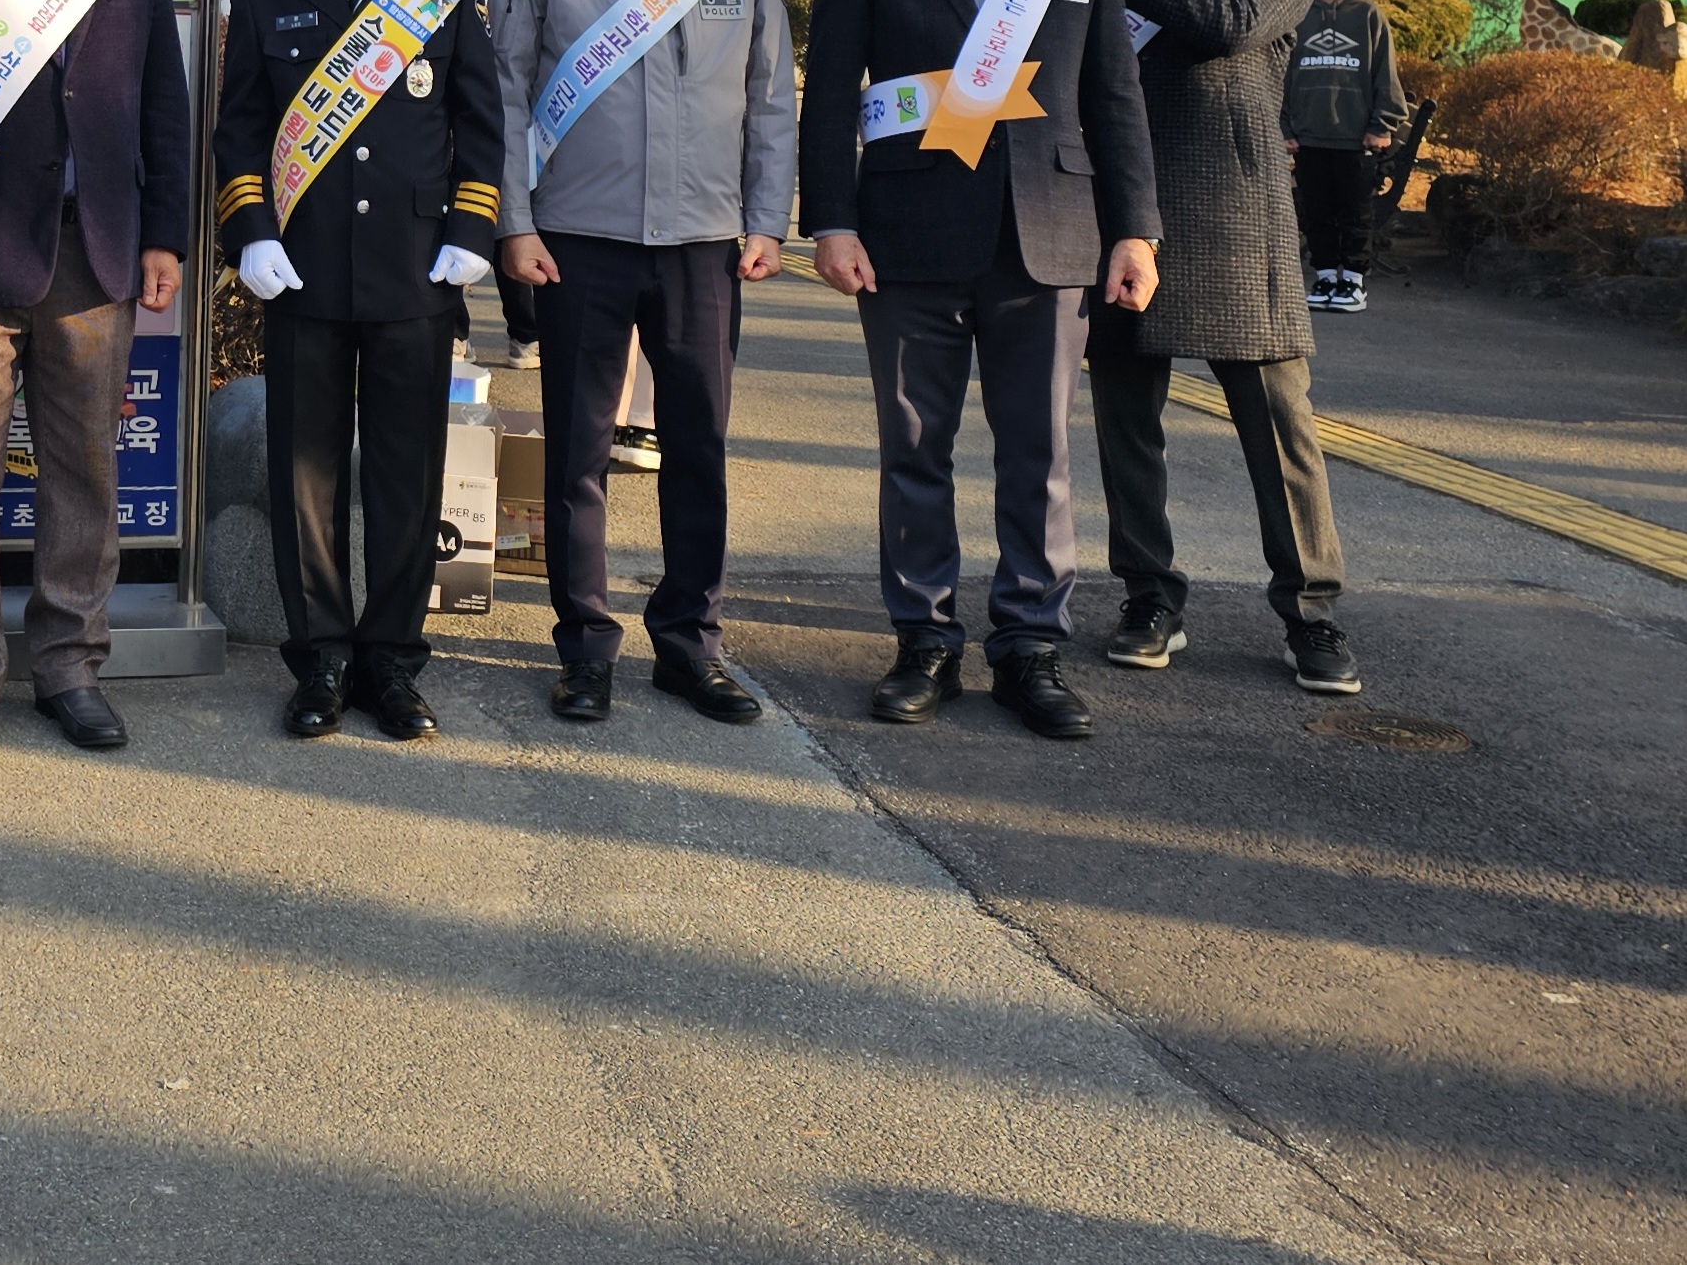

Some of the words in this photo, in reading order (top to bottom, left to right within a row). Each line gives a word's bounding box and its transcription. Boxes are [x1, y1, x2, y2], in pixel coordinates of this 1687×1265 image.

[705, 7, 741, 16] POLICE
[324, 15, 384, 84] 스쿨존
[971, 19, 1015, 88] 도로교통
[302, 81, 333, 113] 내
[359, 64, 386, 87] STOP
[301, 87, 366, 164] 반드시
[547, 79, 577, 127] 근절
[275, 162, 308, 225] 일시
[473, 513, 486, 523] 85
